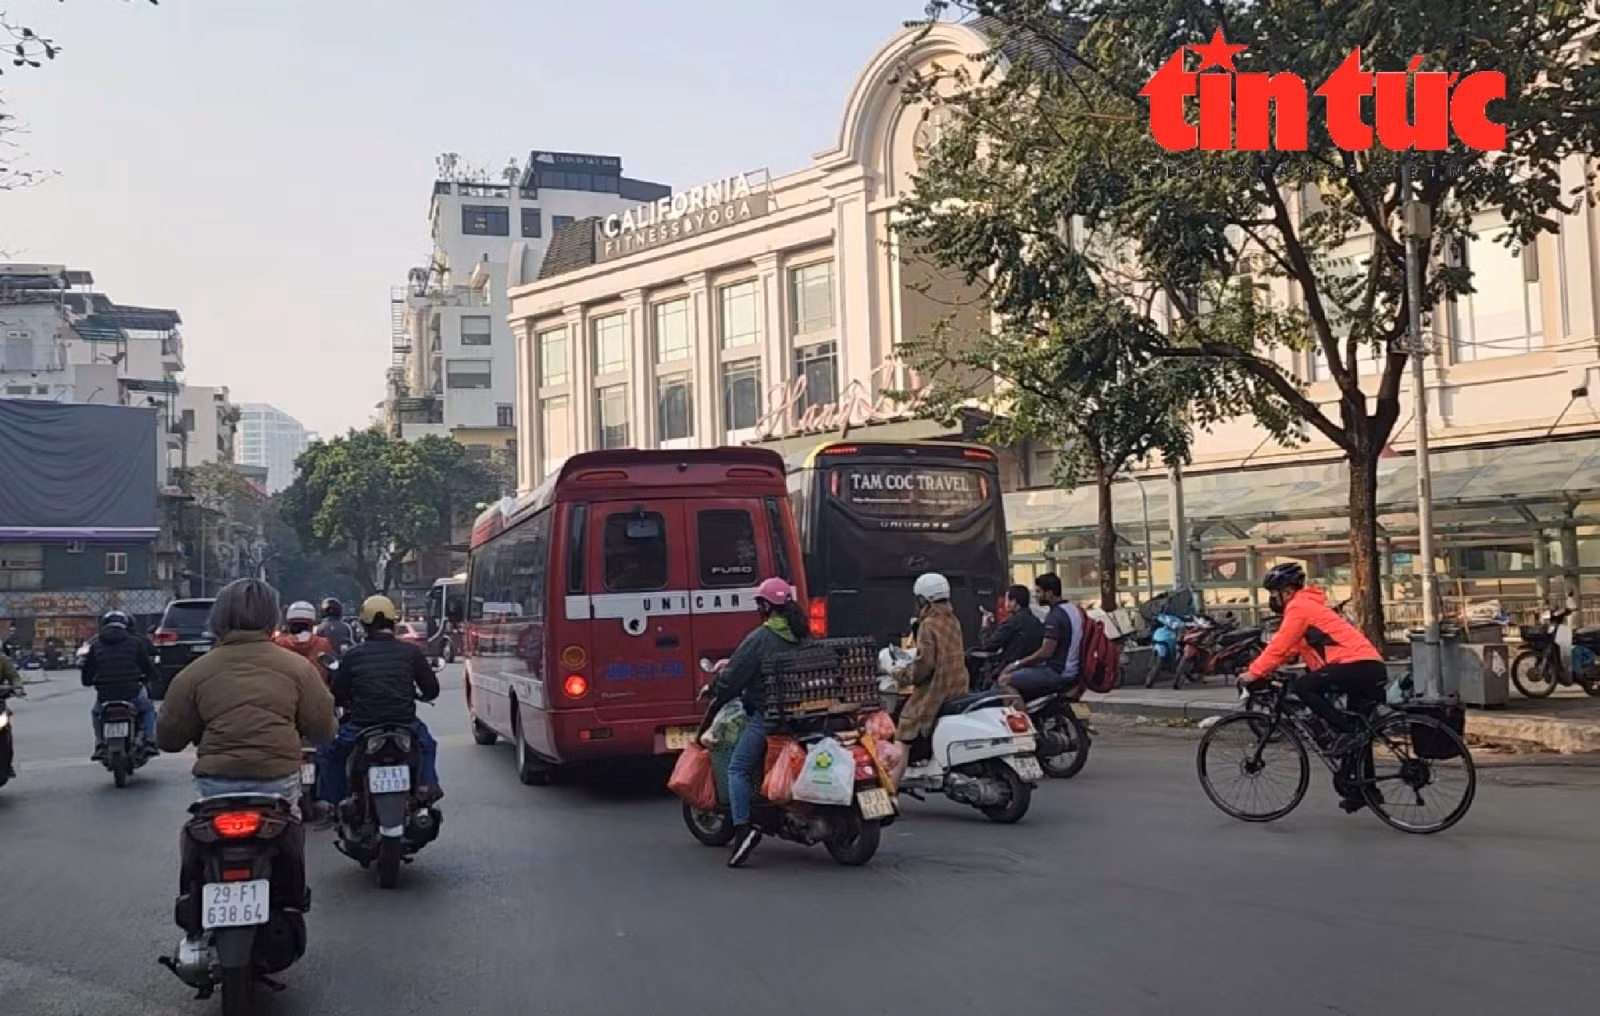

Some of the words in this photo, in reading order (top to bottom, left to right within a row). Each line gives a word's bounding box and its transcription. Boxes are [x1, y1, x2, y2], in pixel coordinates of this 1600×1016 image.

[604, 172, 751, 238] CALIFORNIA
[605, 201, 751, 257] FITNESS&YOGA
[851, 474, 883, 490] TAM
[885, 474, 914, 490] COC
[916, 475, 969, 492] TRAVEL
[711, 566, 752, 574] FUSO
[643, 594, 740, 611] UNICAR
[213, 884, 257, 904] 29-F1
[207, 903, 262, 924] 638.64
